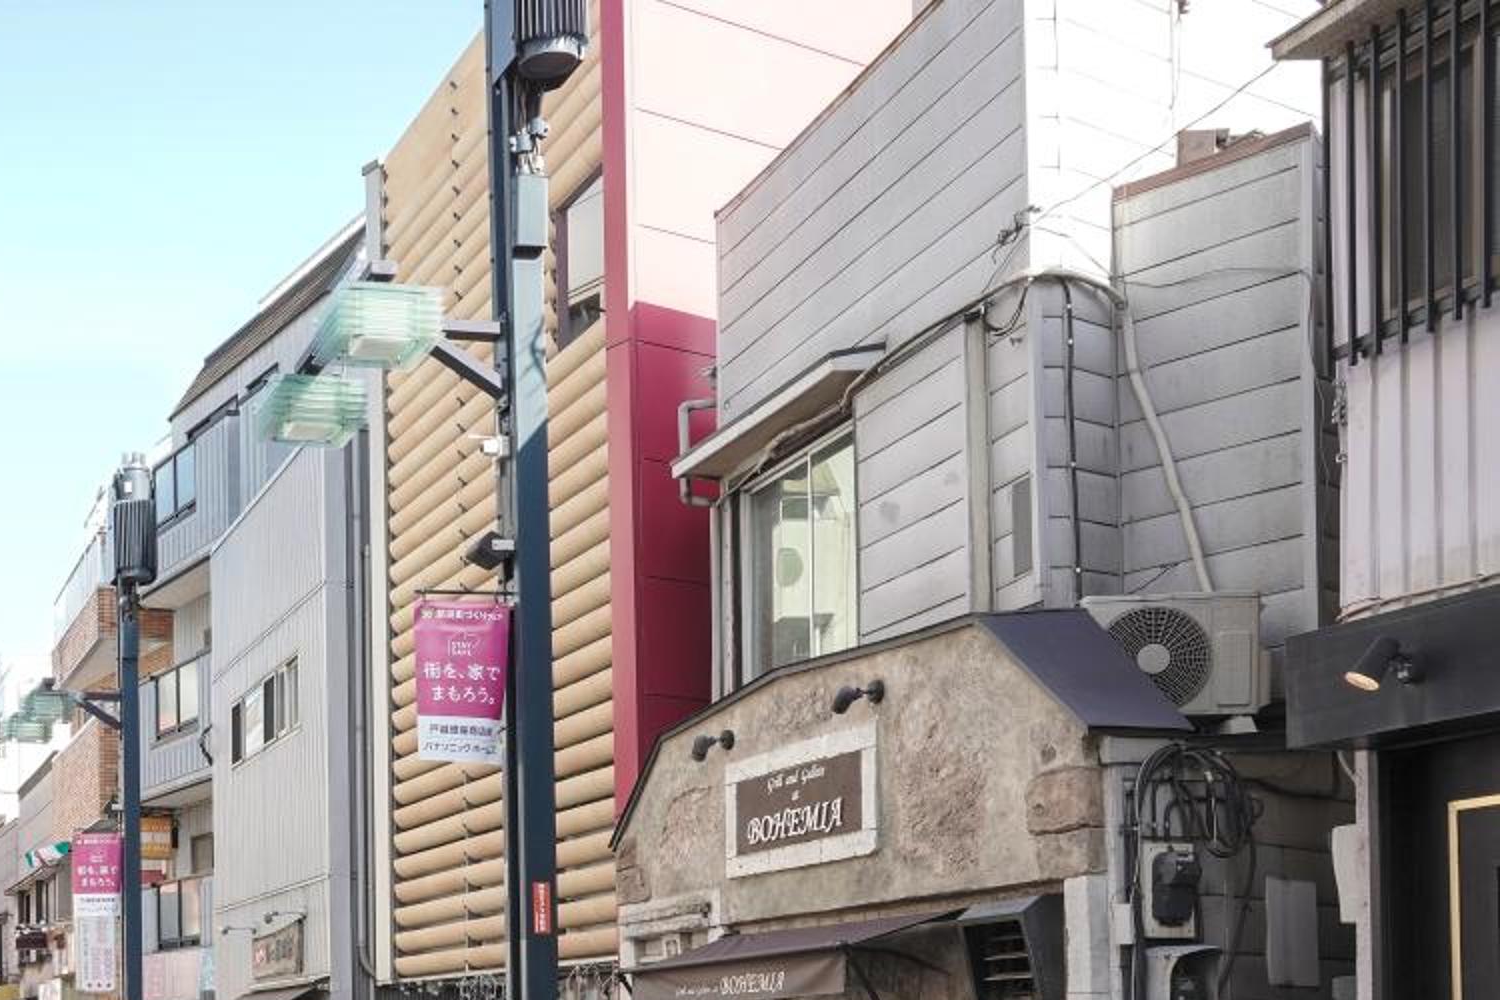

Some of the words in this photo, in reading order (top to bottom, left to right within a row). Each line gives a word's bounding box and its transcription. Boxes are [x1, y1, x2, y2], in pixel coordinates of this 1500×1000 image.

[431, 686, 496, 704] まもろう。
[747, 797, 843, 844] BOHEMIA
